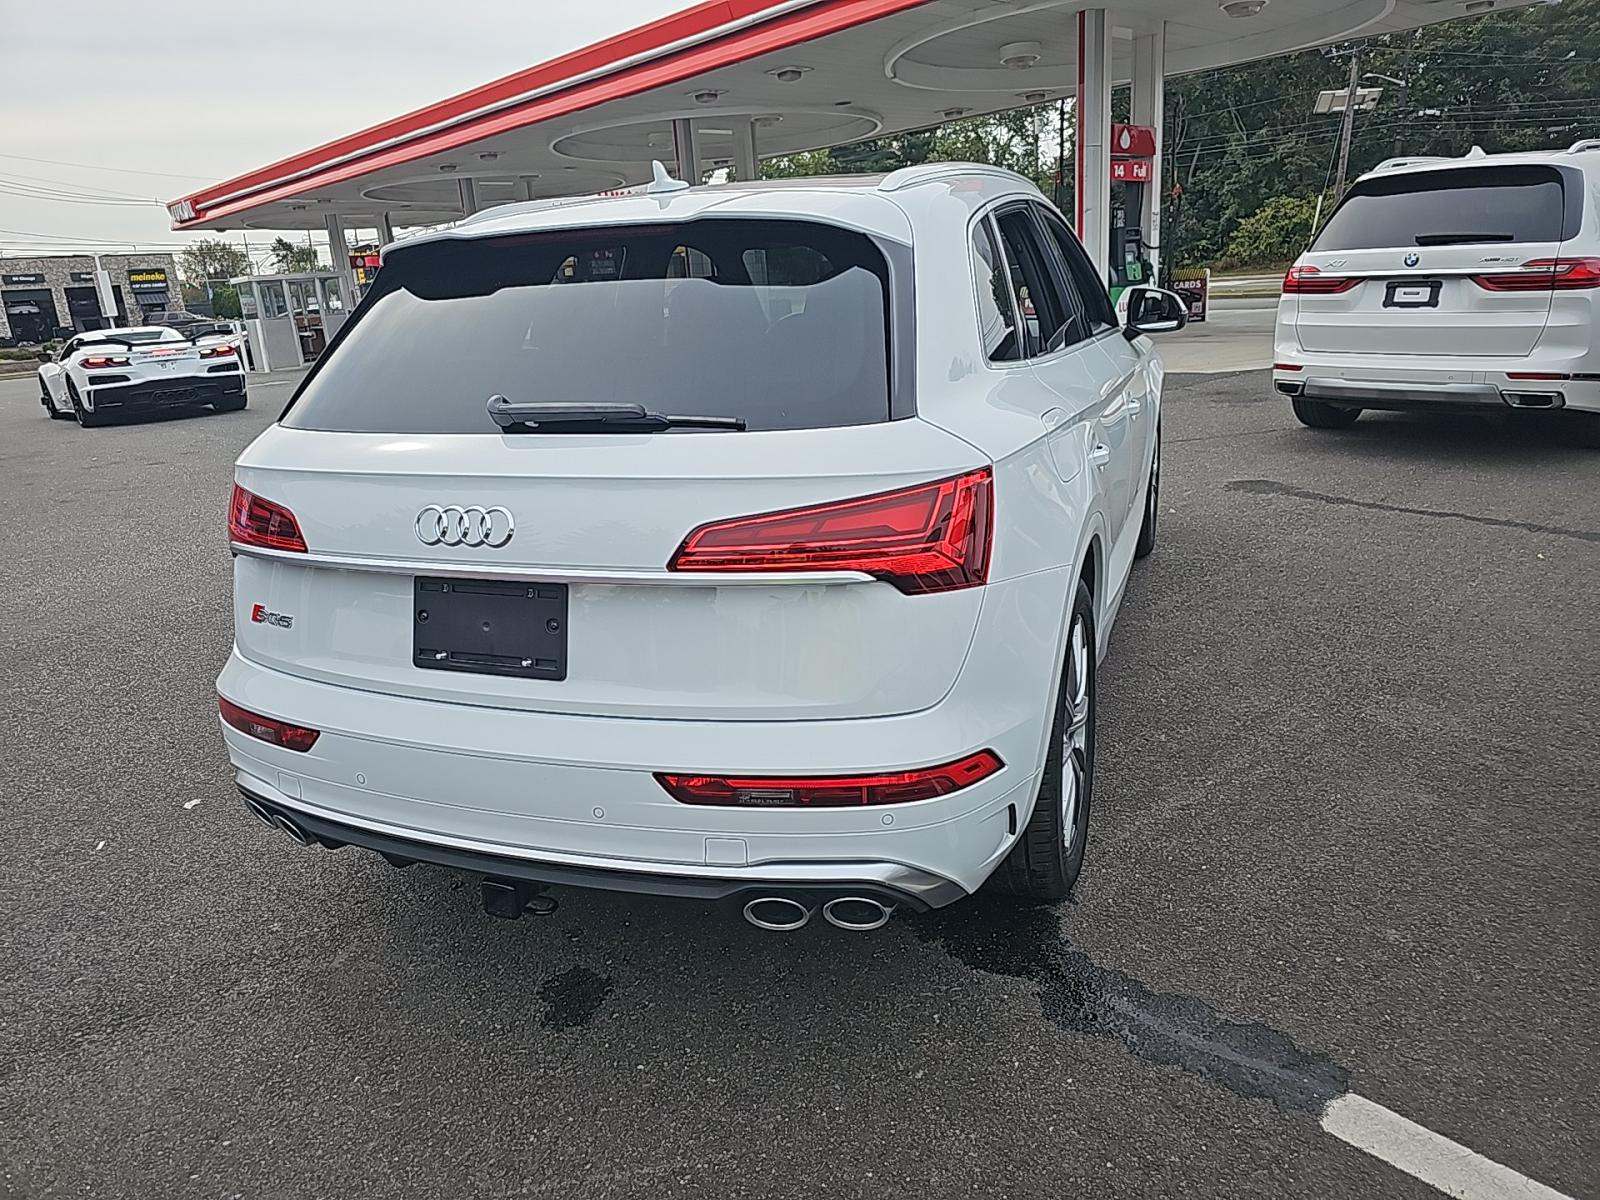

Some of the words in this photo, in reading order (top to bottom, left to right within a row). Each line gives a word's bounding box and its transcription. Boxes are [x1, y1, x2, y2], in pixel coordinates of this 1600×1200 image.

[1113, 164, 1125, 178] 14
[130, 271, 166, 282] meineke
[1173, 280, 1202, 290] CARDS
